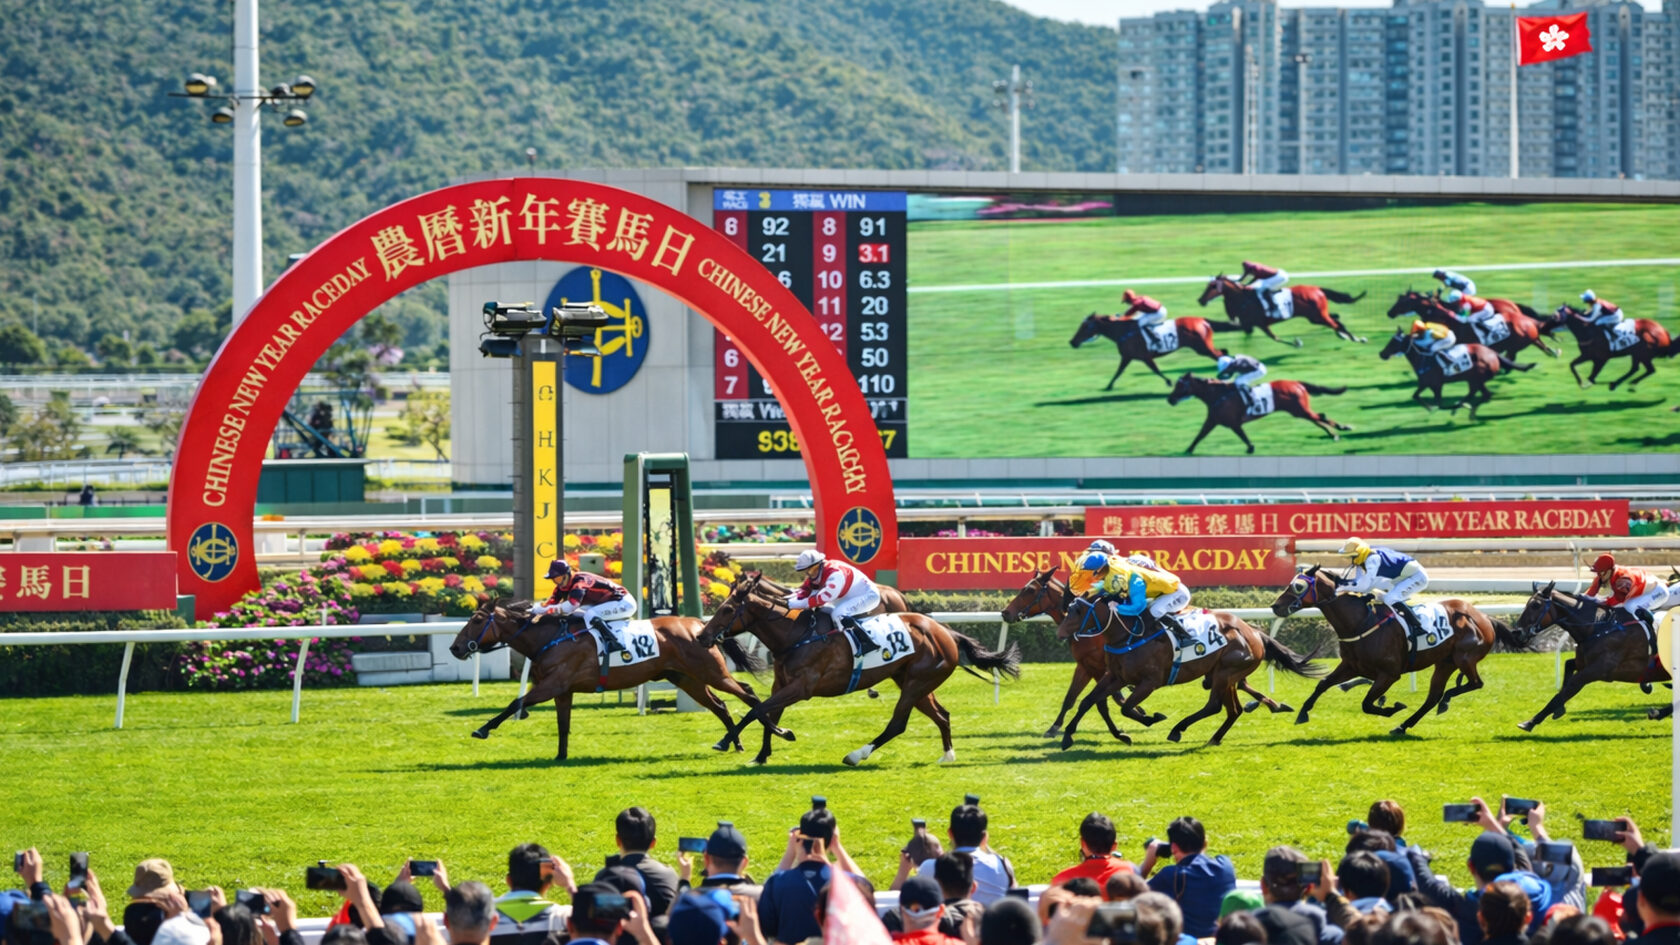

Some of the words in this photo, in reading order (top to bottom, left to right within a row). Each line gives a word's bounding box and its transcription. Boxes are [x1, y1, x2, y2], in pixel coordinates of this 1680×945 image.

[829, 193, 866, 209] WIN
[724, 217, 738, 235] 6
[762, 217, 790, 236] 92
[822, 217, 837, 236] 8
[859, 217, 886, 236] 91
[371, 193, 695, 282] 農曆新年賽馬日
[762, 243, 786, 263] 21
[822, 243, 837, 263] 9
[859, 243, 889, 264] 3.1
[817, 271, 843, 289] 10
[859, 270, 891, 290] 6.3
[817, 297, 841, 315] 11
[861, 296, 889, 316] 20
[697, 257, 771, 323] CHINESE
[763, 311, 806, 356] NEW
[795, 351, 834, 407] YEAR
[820, 323, 843, 341] 12
[860, 322, 889, 342] 53
[724, 349, 739, 368] 6
[861, 348, 889, 368] 50
[202, 413, 246, 507] CHINESE
[228, 361, 269, 416] NEW
[254, 323, 302, 374] YEAR
[289, 257, 373, 331] RACEDAY
[724, 376, 739, 394] 7
[858, 374, 895, 394] 110
[1289, 511, 1391, 534] CHINESE
[1394, 511, 1450, 532] NEW
[1451, 510, 1511, 531] YEAR
[1514, 508, 1616, 530] RACEDAY
[925, 551, 1050, 574] CHINESE
[1207, 624, 1224, 646] 4
